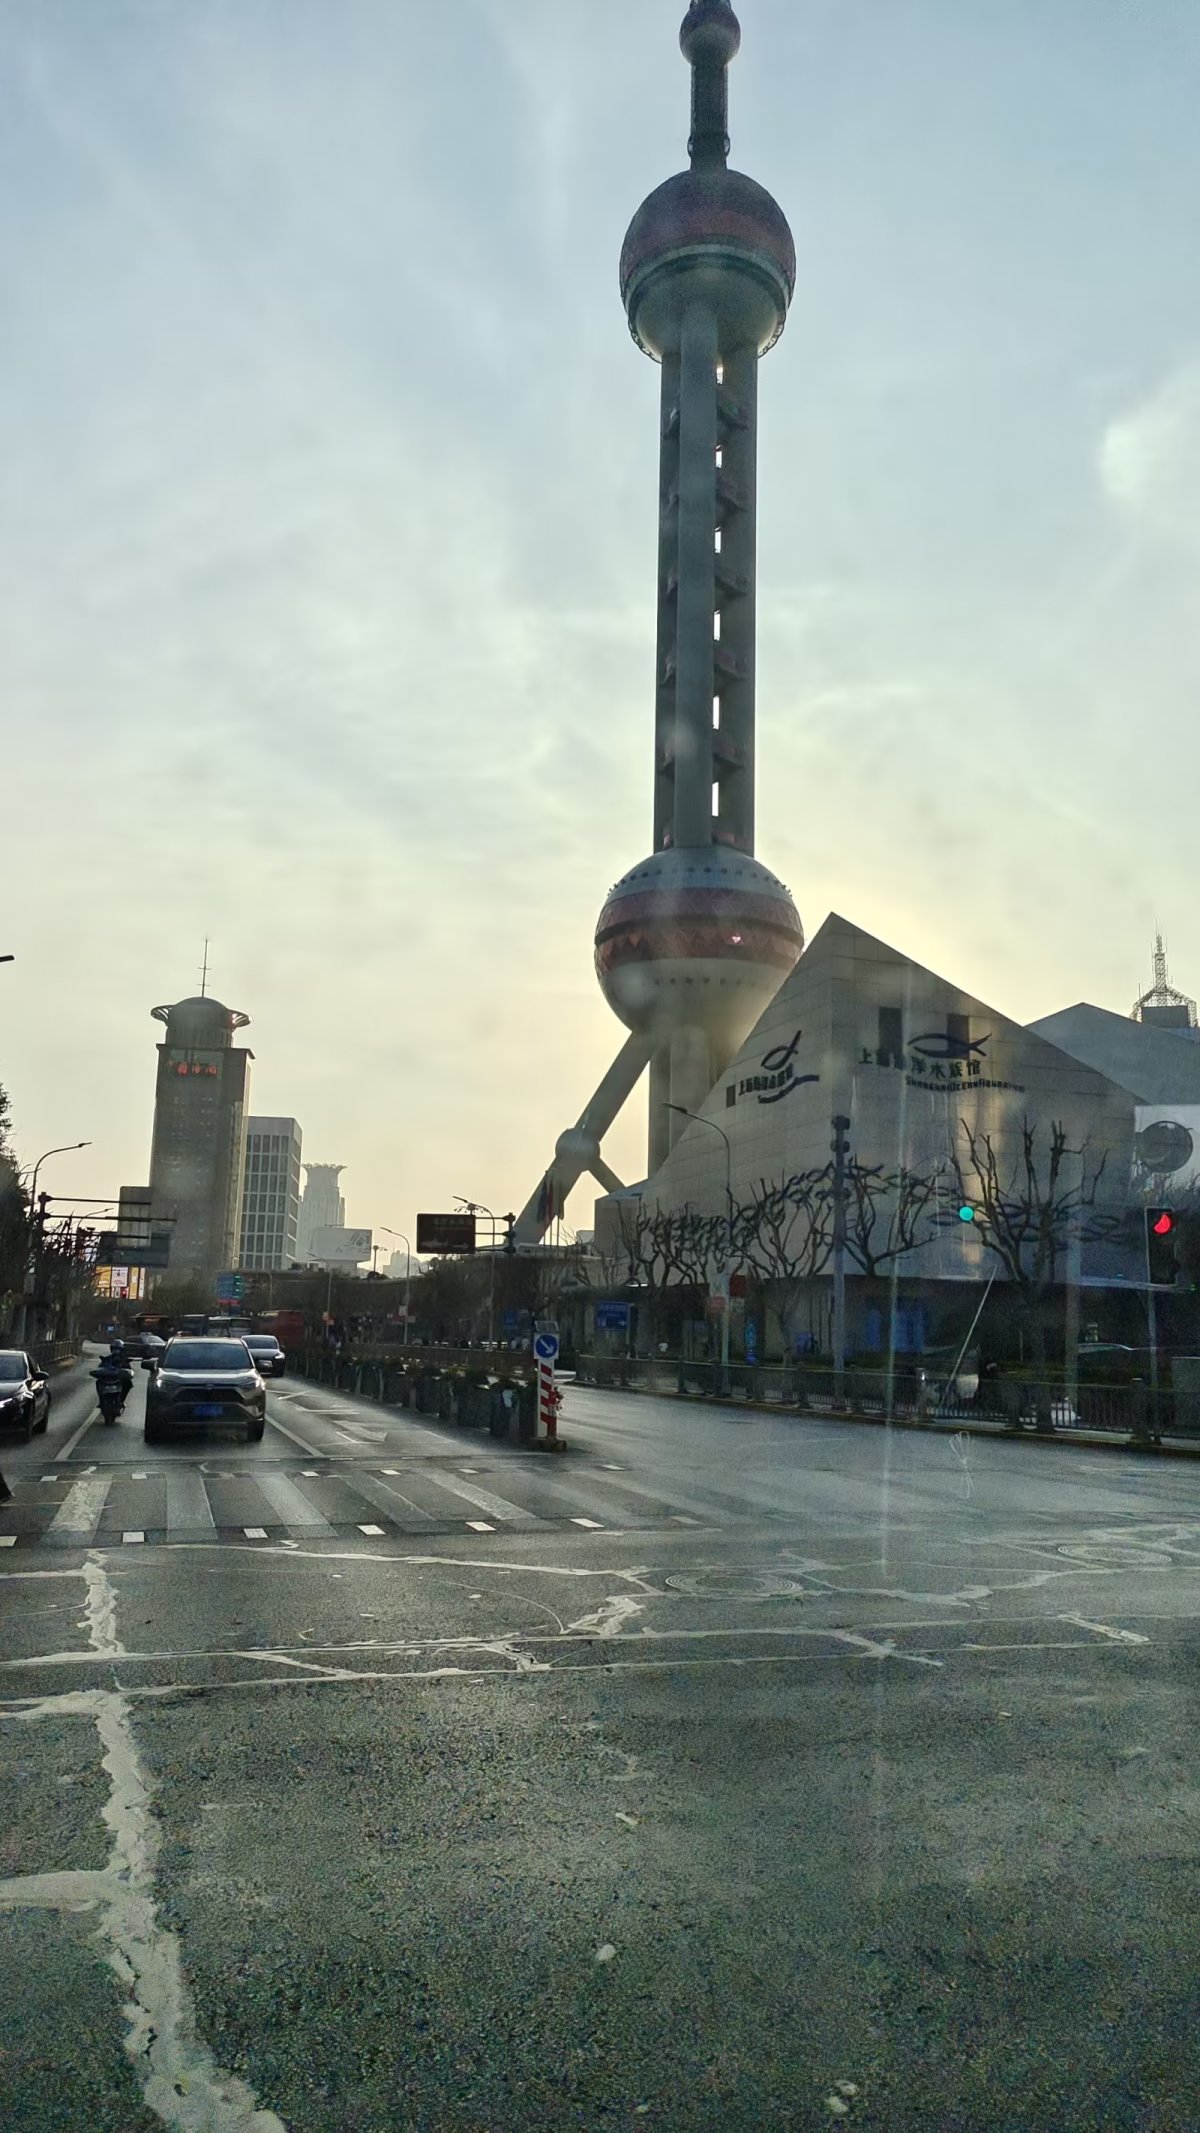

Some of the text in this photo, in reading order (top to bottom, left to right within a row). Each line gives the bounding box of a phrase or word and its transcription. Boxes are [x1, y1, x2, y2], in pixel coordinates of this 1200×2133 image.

[858, 1047, 981, 1079] 上洋水族馆
